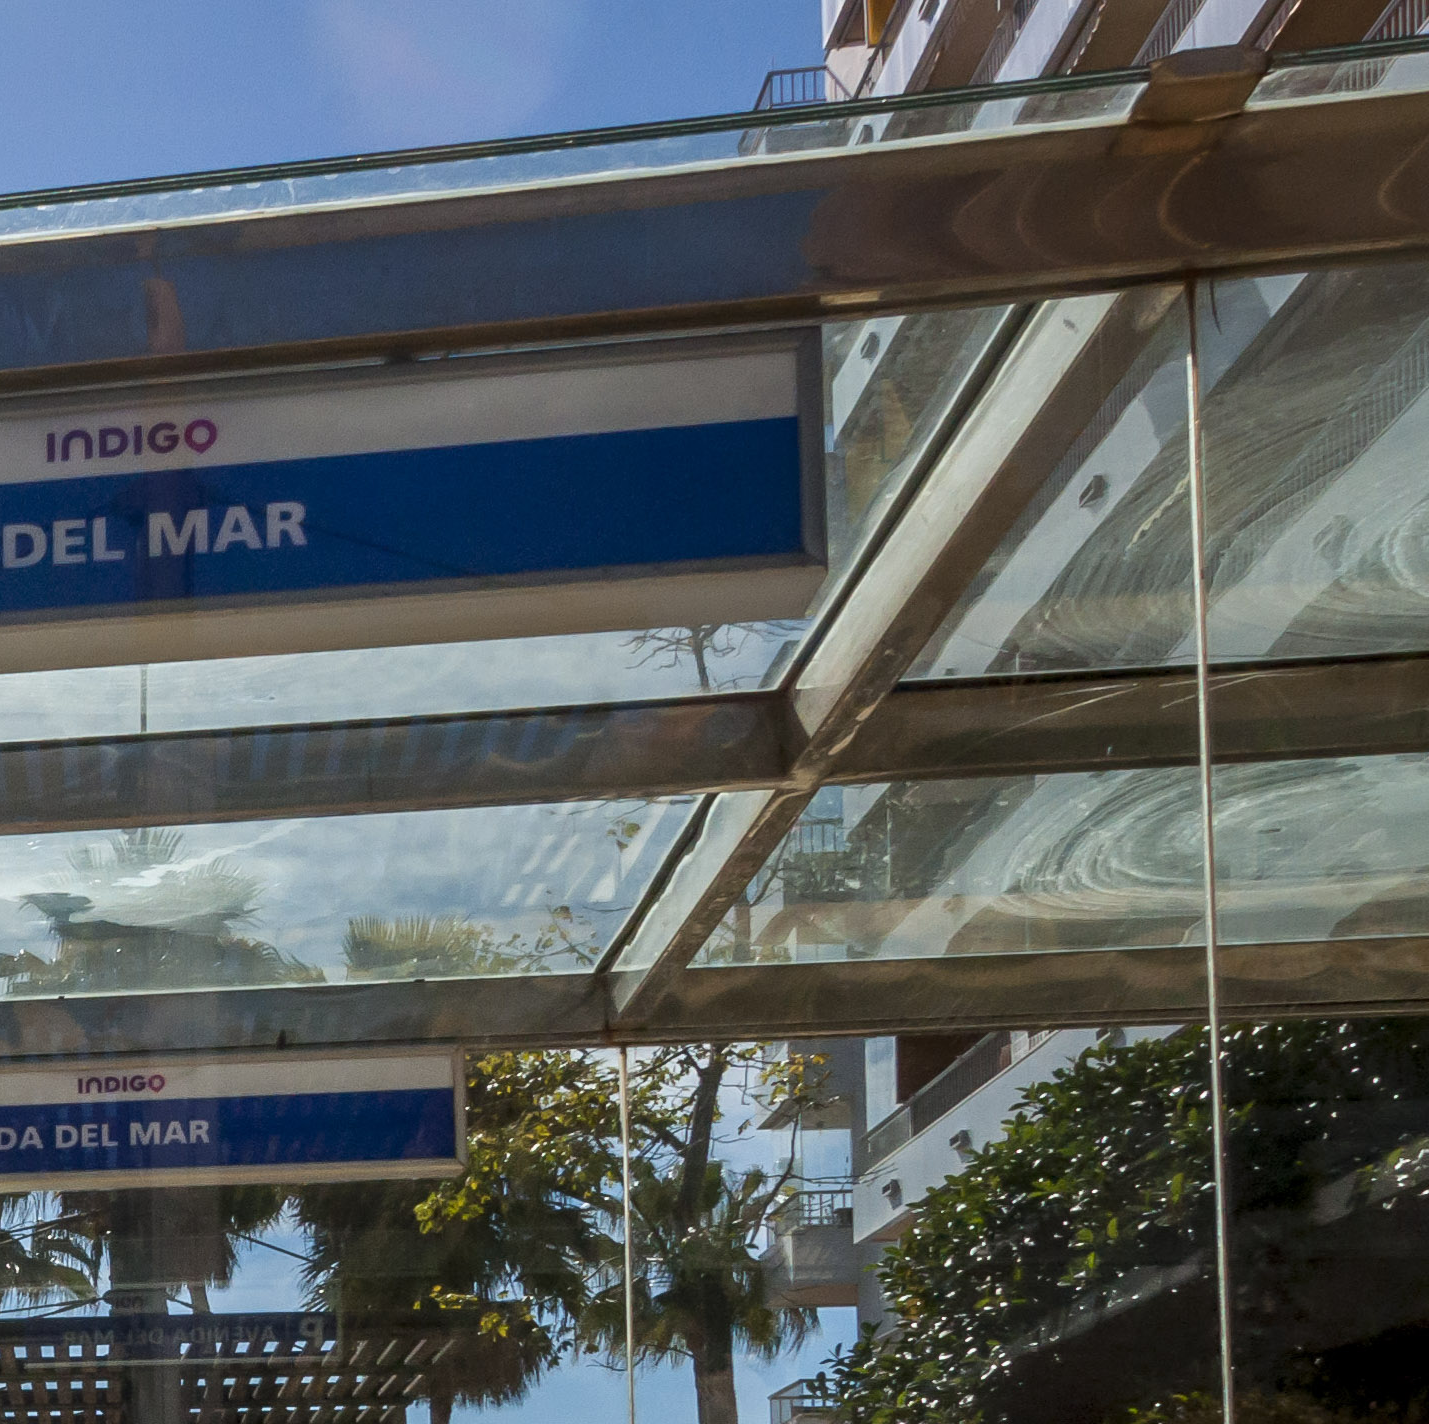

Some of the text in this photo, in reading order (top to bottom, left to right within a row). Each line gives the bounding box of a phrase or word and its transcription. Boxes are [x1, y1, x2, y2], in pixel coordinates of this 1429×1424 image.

[45, 419, 218, 462] INDIGO
[2, 516, 125, 568] DEL
[148, 501, 308, 557] MAR
[78, 1074, 165, 1094] INDIGO
[55, 1123, 118, 1149] DEL
[130, 1120, 210, 1146] MAR
